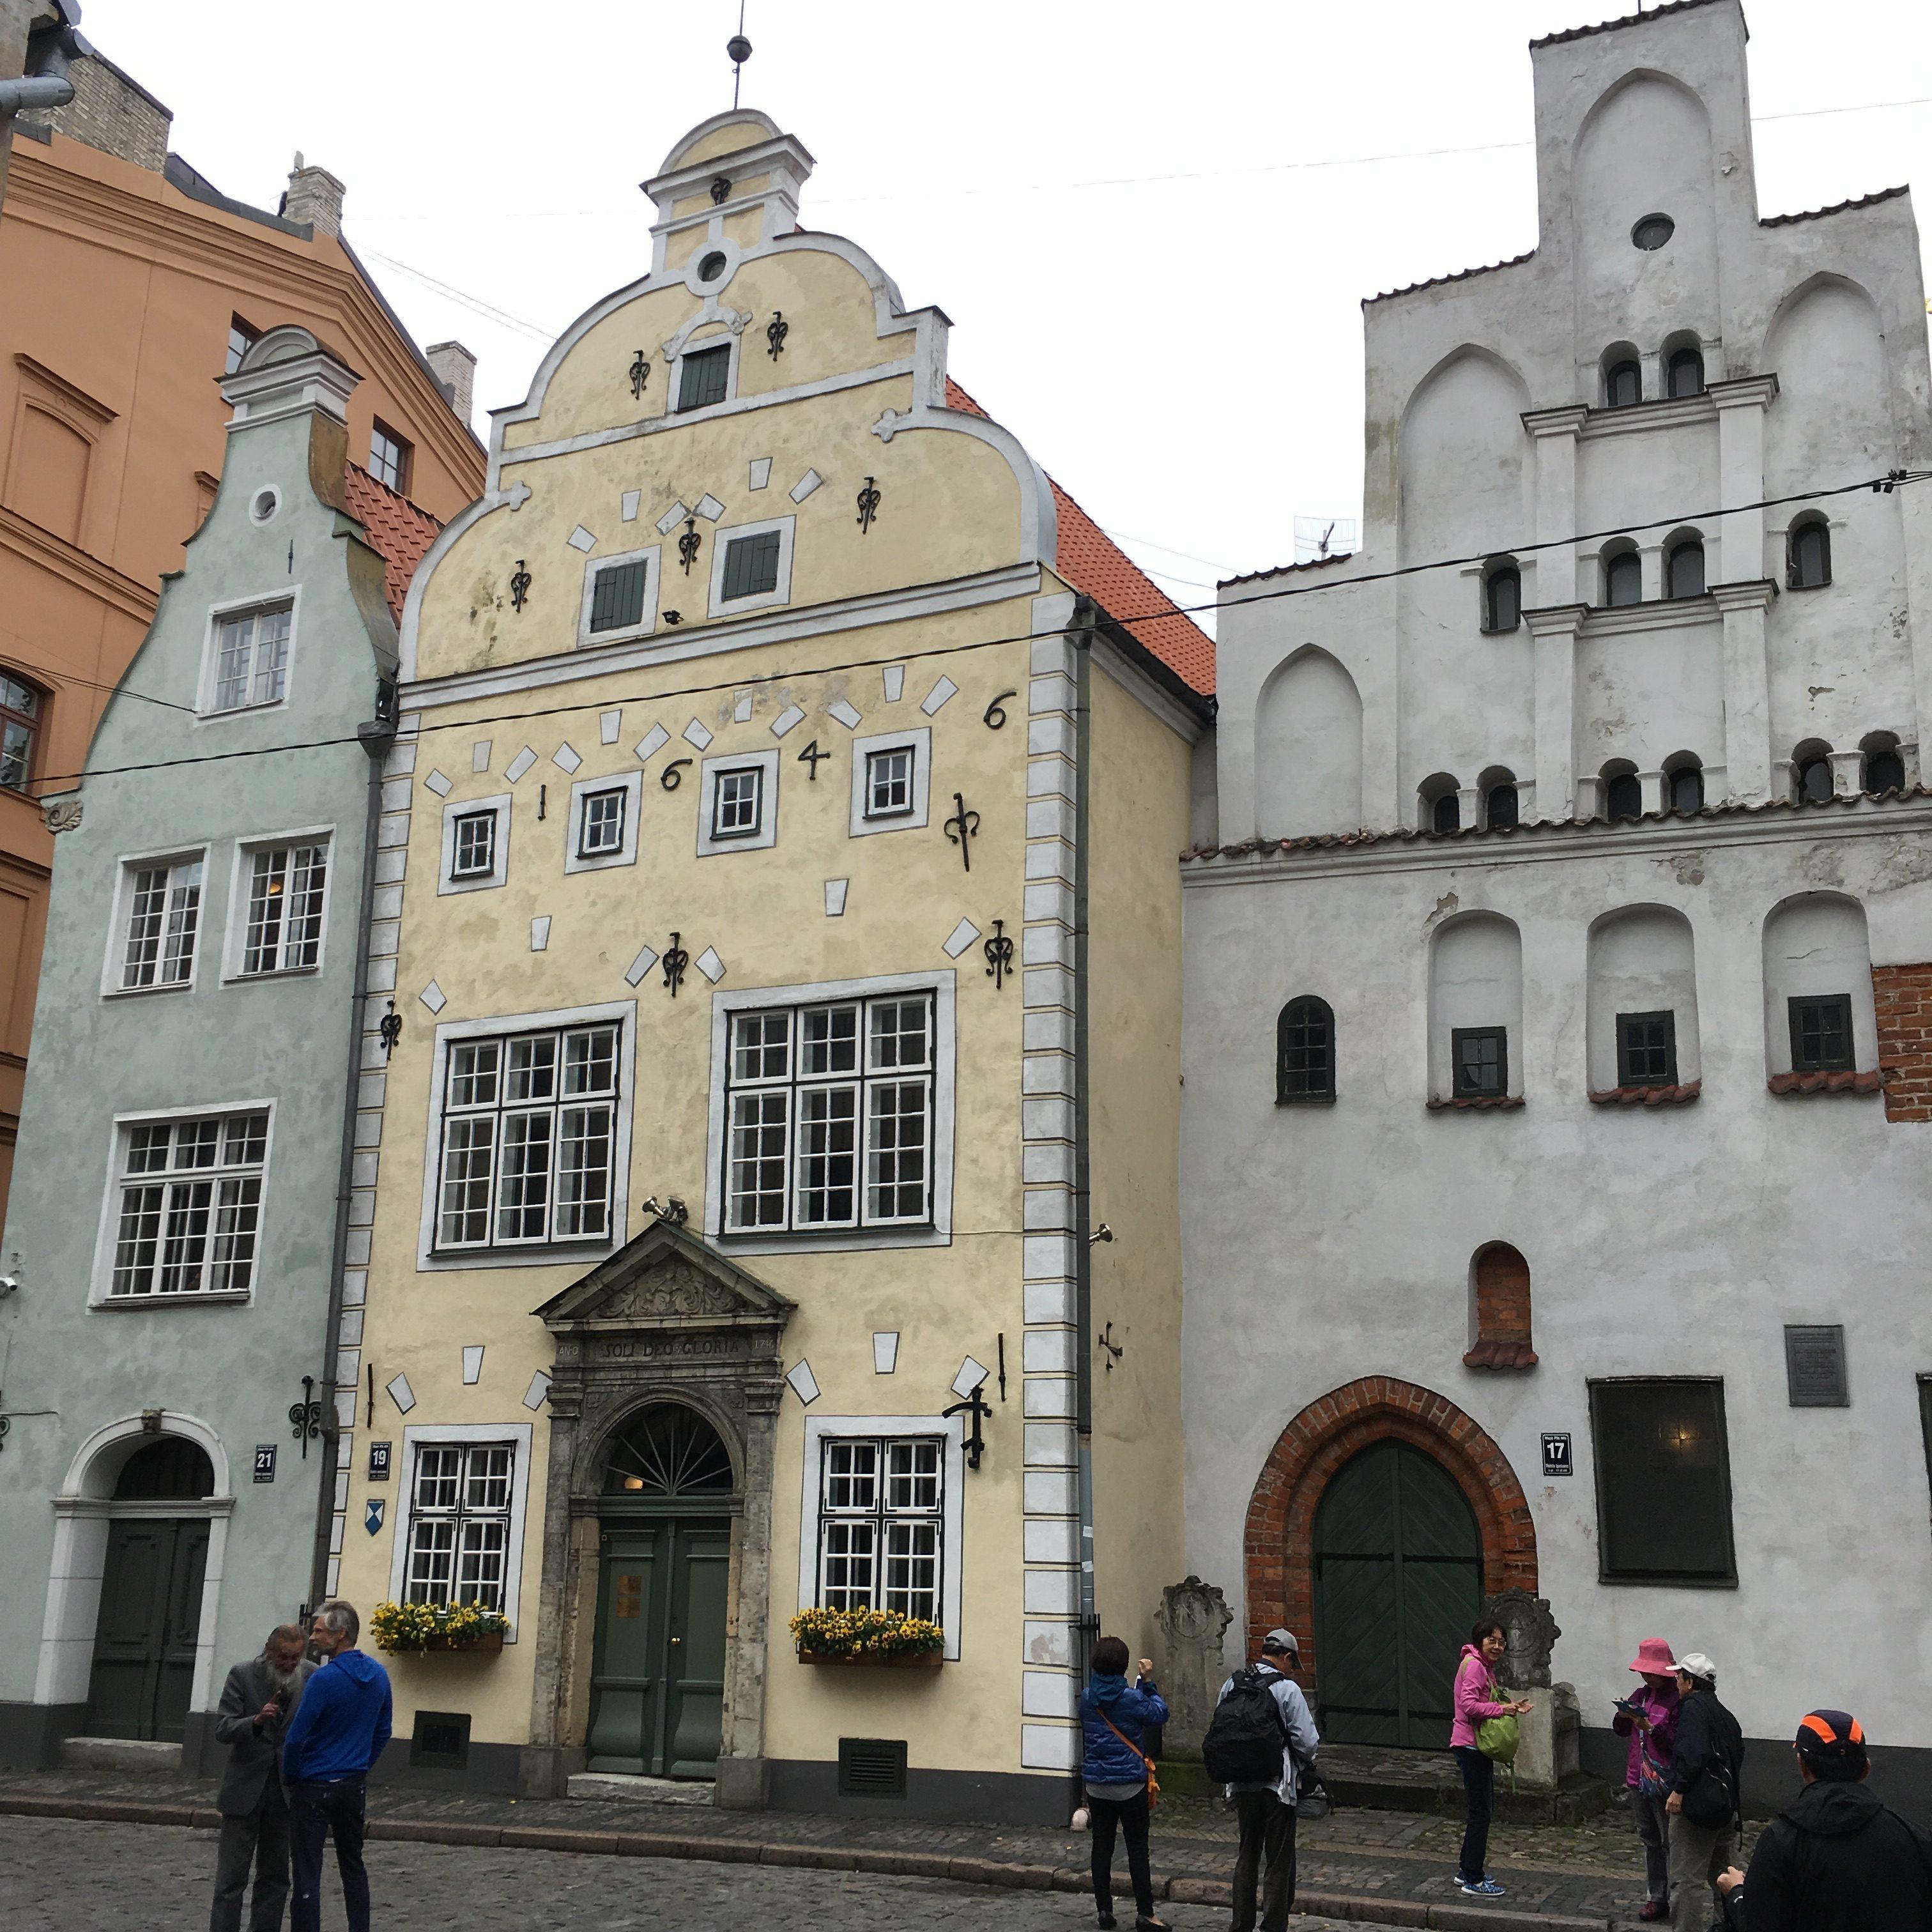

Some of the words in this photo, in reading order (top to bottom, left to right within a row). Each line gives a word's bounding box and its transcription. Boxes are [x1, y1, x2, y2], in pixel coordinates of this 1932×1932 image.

[661, 758, 693, 792] 6
[797, 739, 831, 780] 4
[983, 691, 1016, 730] 6
[643, 1343, 671, 1356] DEO
[683, 1341, 739, 1354] GLORIA
[373, 1450, 387, 1465] 19
[1547, 1442, 1565, 1459] 17
[257, 1453, 272, 1468] 21
